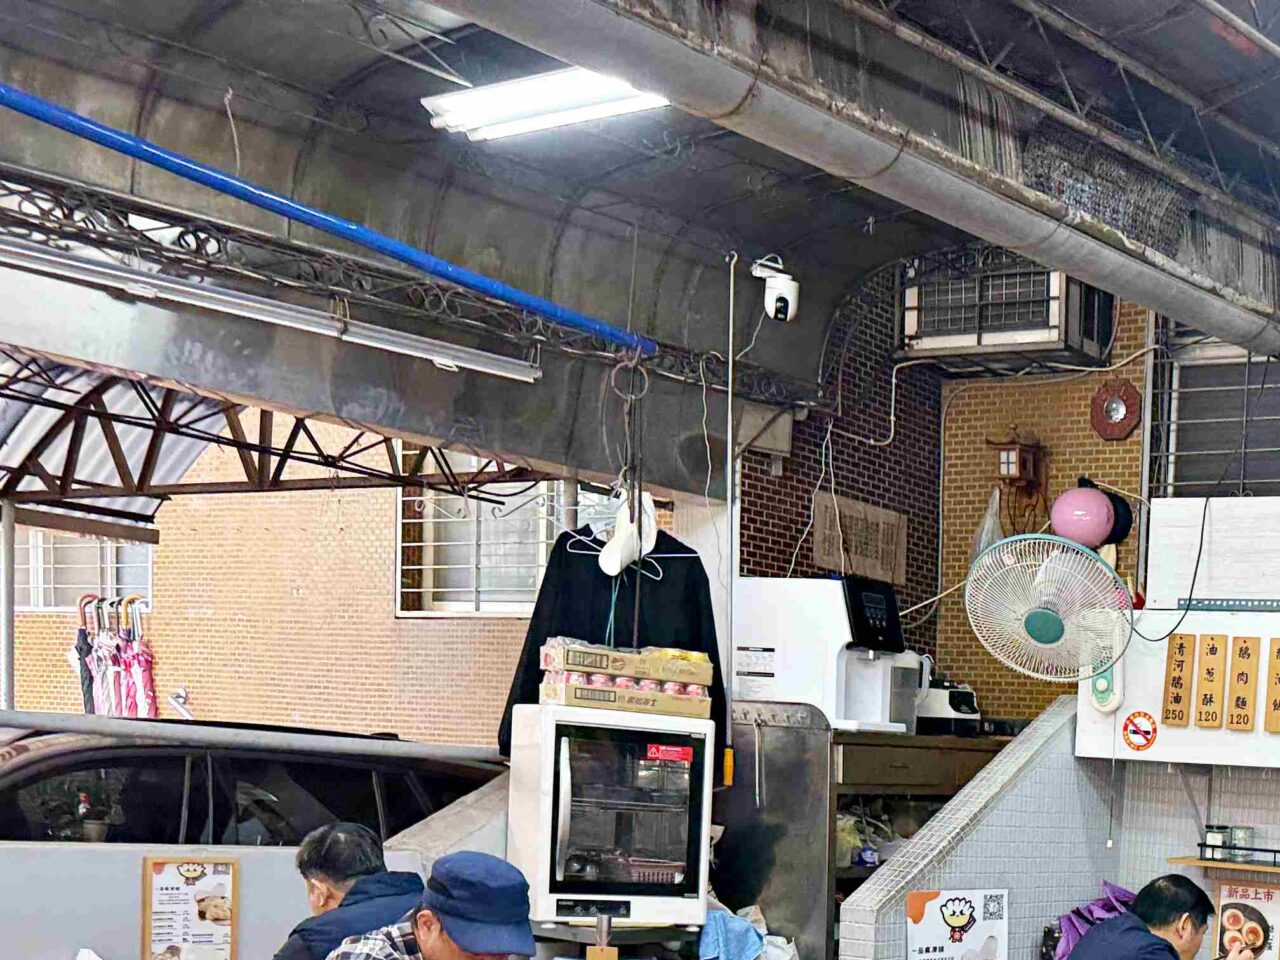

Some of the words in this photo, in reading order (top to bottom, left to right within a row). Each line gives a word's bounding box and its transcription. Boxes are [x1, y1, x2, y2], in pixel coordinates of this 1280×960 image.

[1170, 642, 1186, 705] 清河鵝油
[1234, 646, 1250, 710] 鵝肉麵
[1165, 709, 1184, 721] 250
[1198, 710, 1218, 722] 120
[1230, 714, 1249, 725] 120
[1227, 888, 1274, 902] 新品上市
